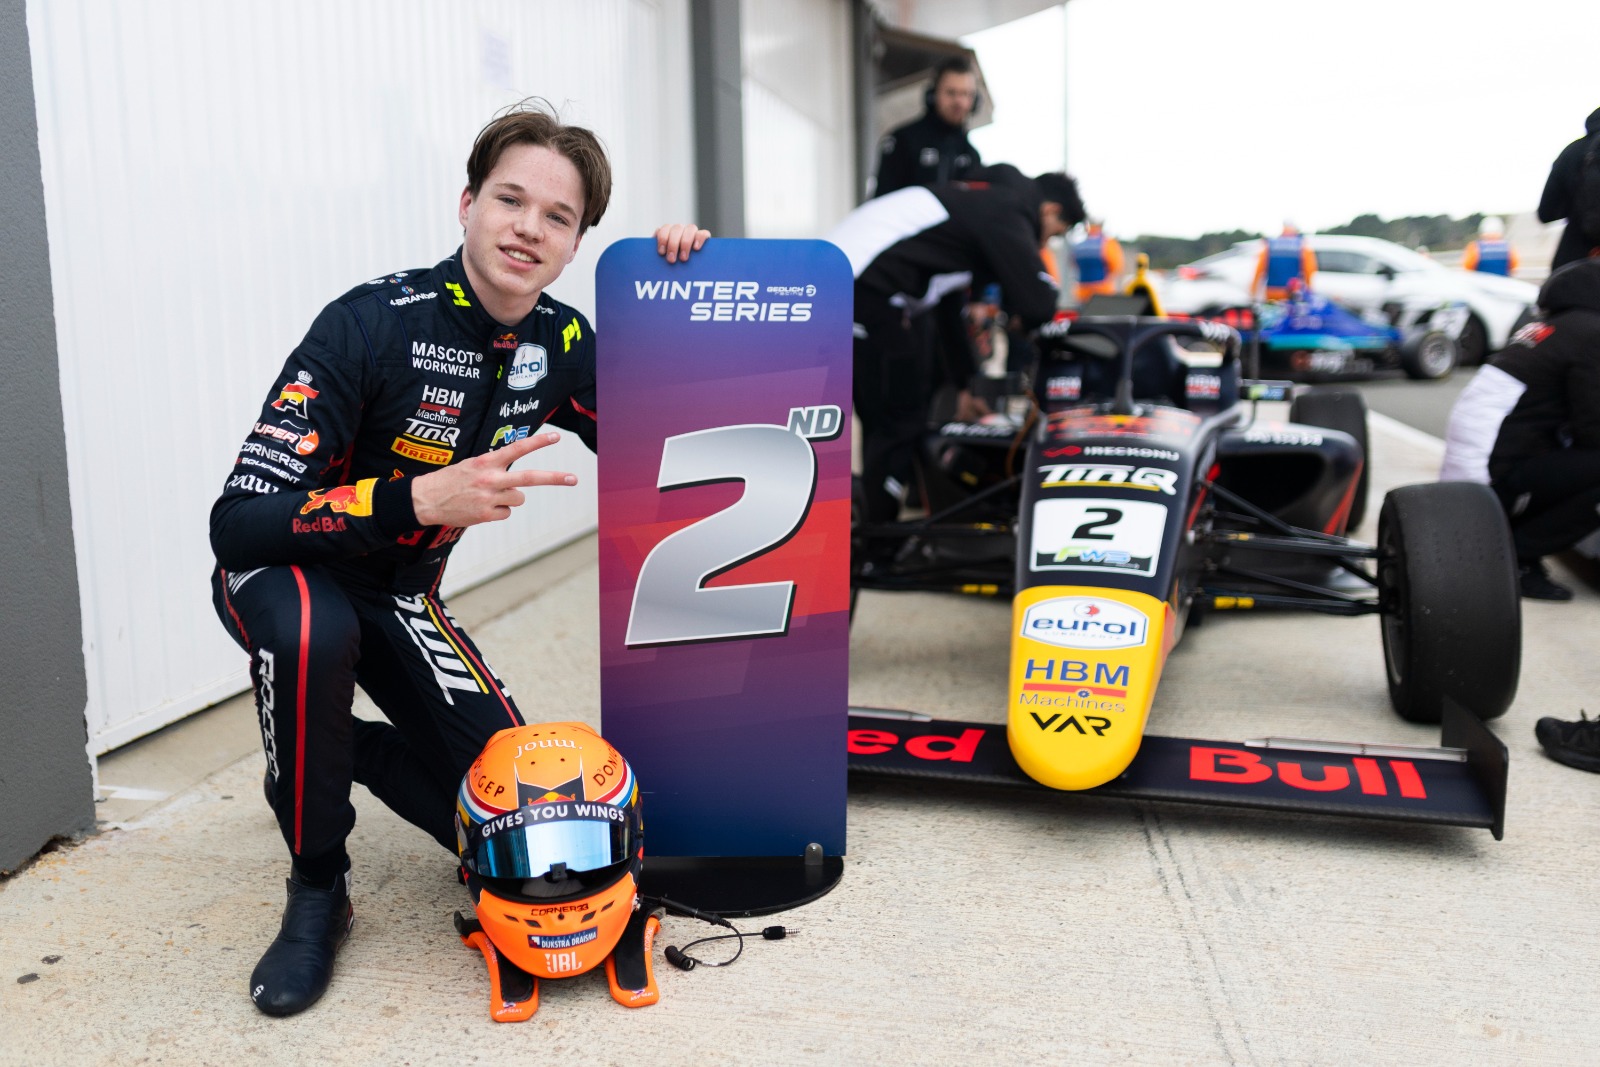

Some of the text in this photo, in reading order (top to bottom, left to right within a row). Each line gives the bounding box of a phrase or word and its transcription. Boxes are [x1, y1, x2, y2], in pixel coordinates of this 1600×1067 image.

[634, 280, 760, 300] WINTER
[689, 302, 813, 321] SERIES
[412, 356, 481, 380] WORKWEAR
[421, 384, 466, 409] HBM
[415, 408, 458, 425] Machines
[395, 439, 450, 463] PIRELLI
[1071, 507, 1123, 541] 2
[1032, 618, 1137, 637] eurol
[1024, 658, 1130, 687] HBM
[1019, 692, 1126, 713] Machines
[1029, 712, 1113, 737] VAR
[848, 729, 985, 764] ed
[1189, 745, 1427, 800] Bull
[482, 804, 625, 838] GIVES YOU WINGS
[531, 902, 589, 917] CORNER33
[541, 939, 571, 949] DIJKSTRA
[544, 951, 582, 974] JBL
